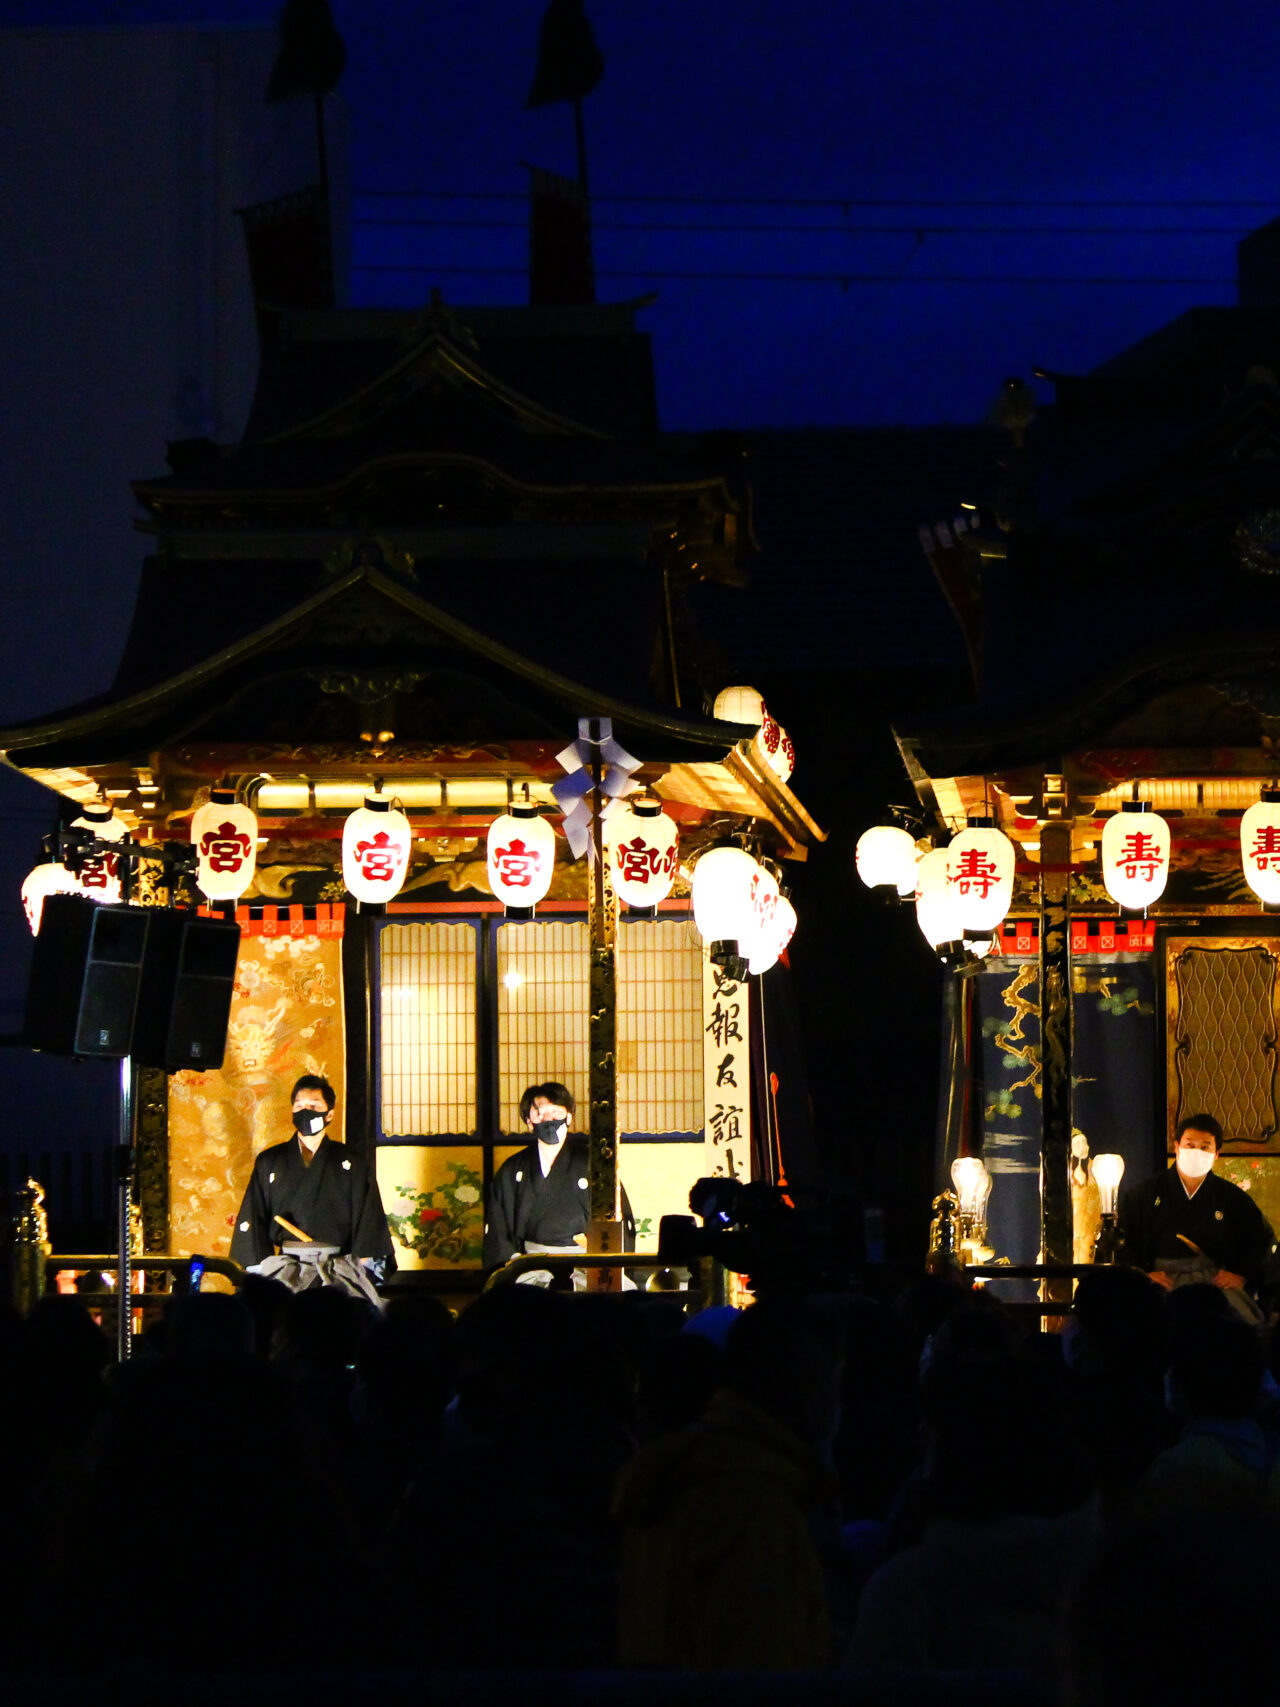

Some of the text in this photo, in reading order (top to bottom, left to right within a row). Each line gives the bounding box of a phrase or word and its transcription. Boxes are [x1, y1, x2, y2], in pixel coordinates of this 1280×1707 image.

[200, 821, 251, 873] 宮
[353, 831, 401, 882] 宮
[492, 838, 542, 888] 宮
[616, 836, 662, 884] 宮
